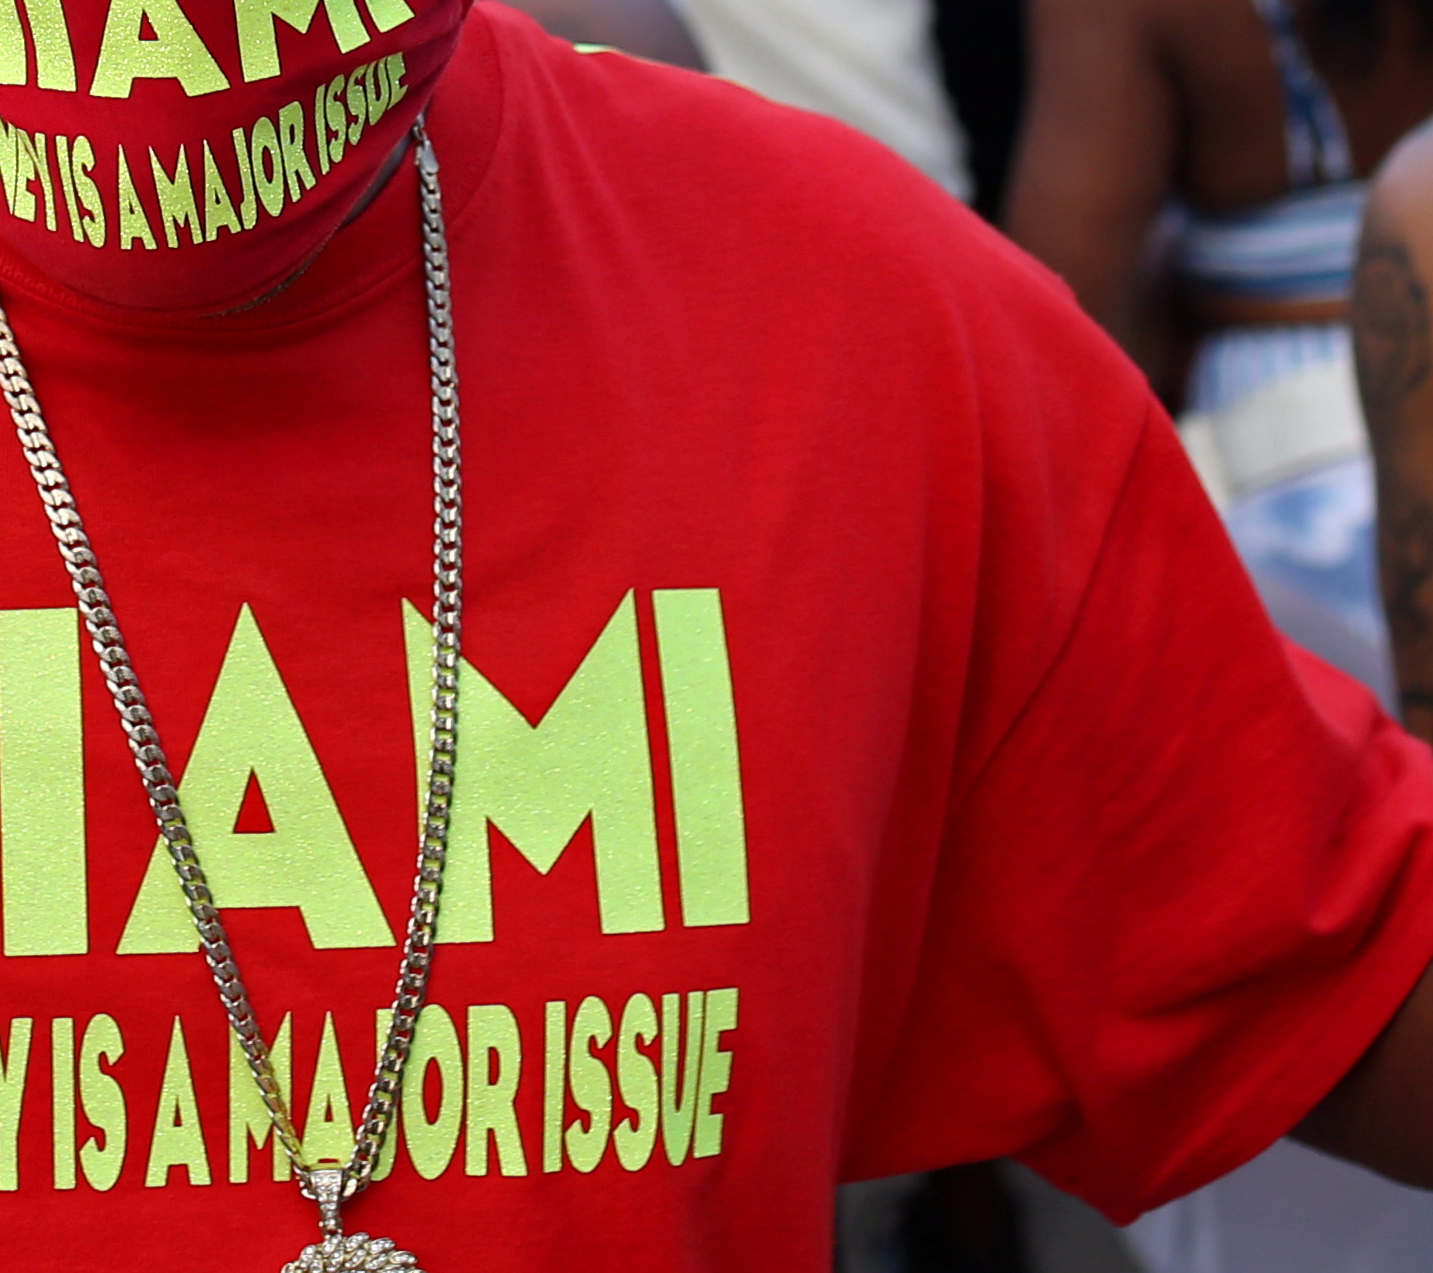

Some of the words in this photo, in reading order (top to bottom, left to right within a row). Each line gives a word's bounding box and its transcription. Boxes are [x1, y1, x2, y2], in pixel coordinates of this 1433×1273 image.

[56, 135, 106, 248] IS
[118, 144, 158, 250] A
[149, 100, 317, 249] MAJOR
[314, 52, 410, 176] ISSUE
[53, 1013, 127, 1192] IS
[144, 1015, 212, 1187] A
[228, 1004, 528, 1183] MAJOR
[542, 988, 739, 1174] ISSUE
